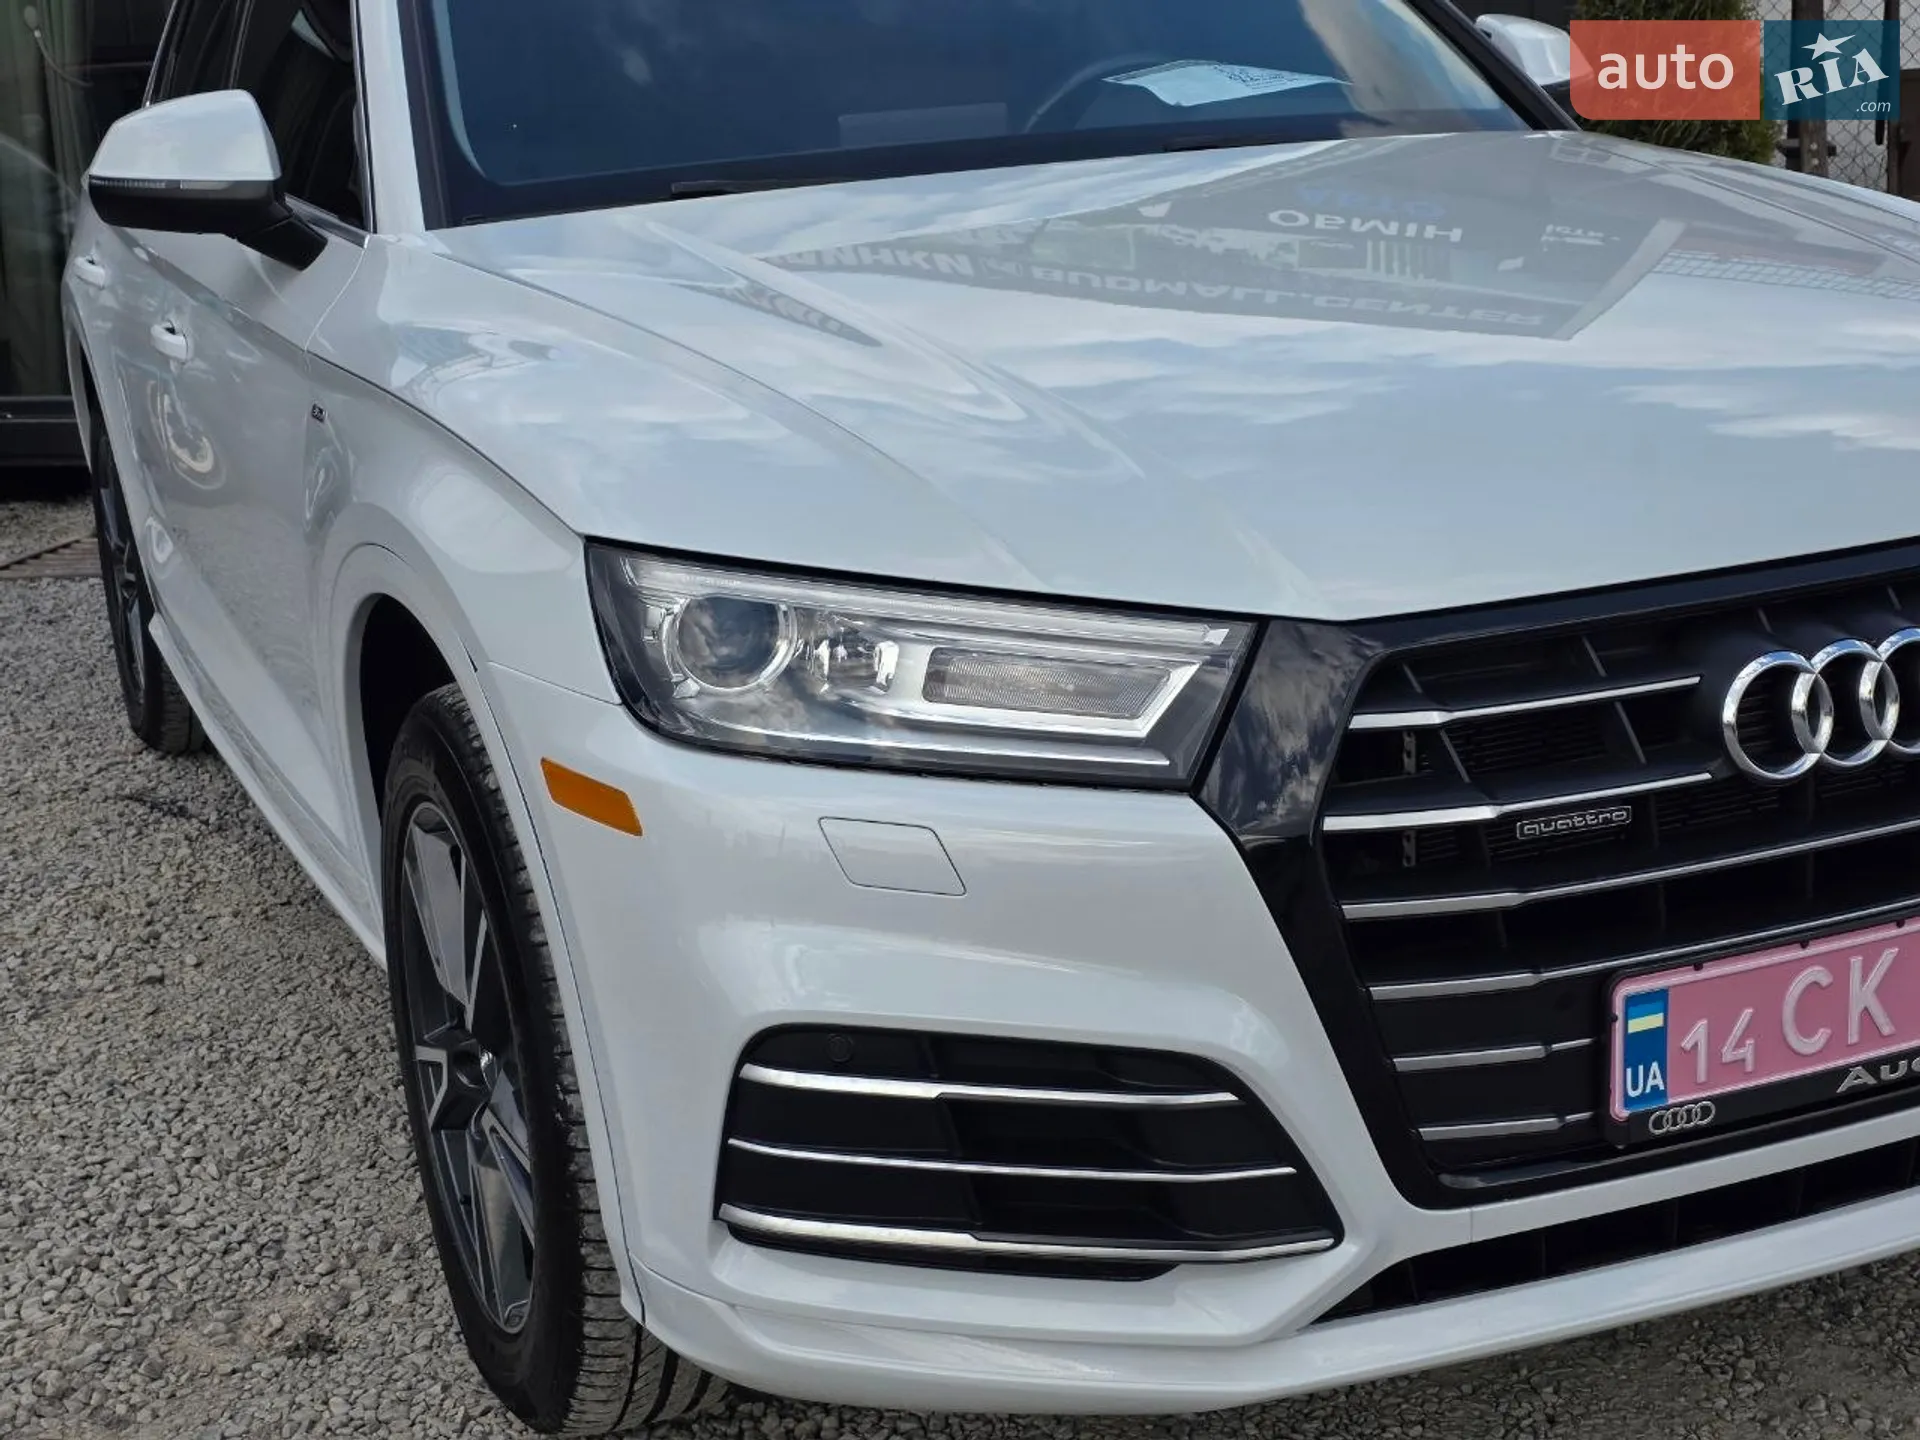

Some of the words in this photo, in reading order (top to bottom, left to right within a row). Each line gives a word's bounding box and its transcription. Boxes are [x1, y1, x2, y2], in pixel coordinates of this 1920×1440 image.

[1523, 810, 1627, 835] quattro
[1681, 1008, 1755, 1084] 14
[1626, 1061, 1665, 1097] UA
